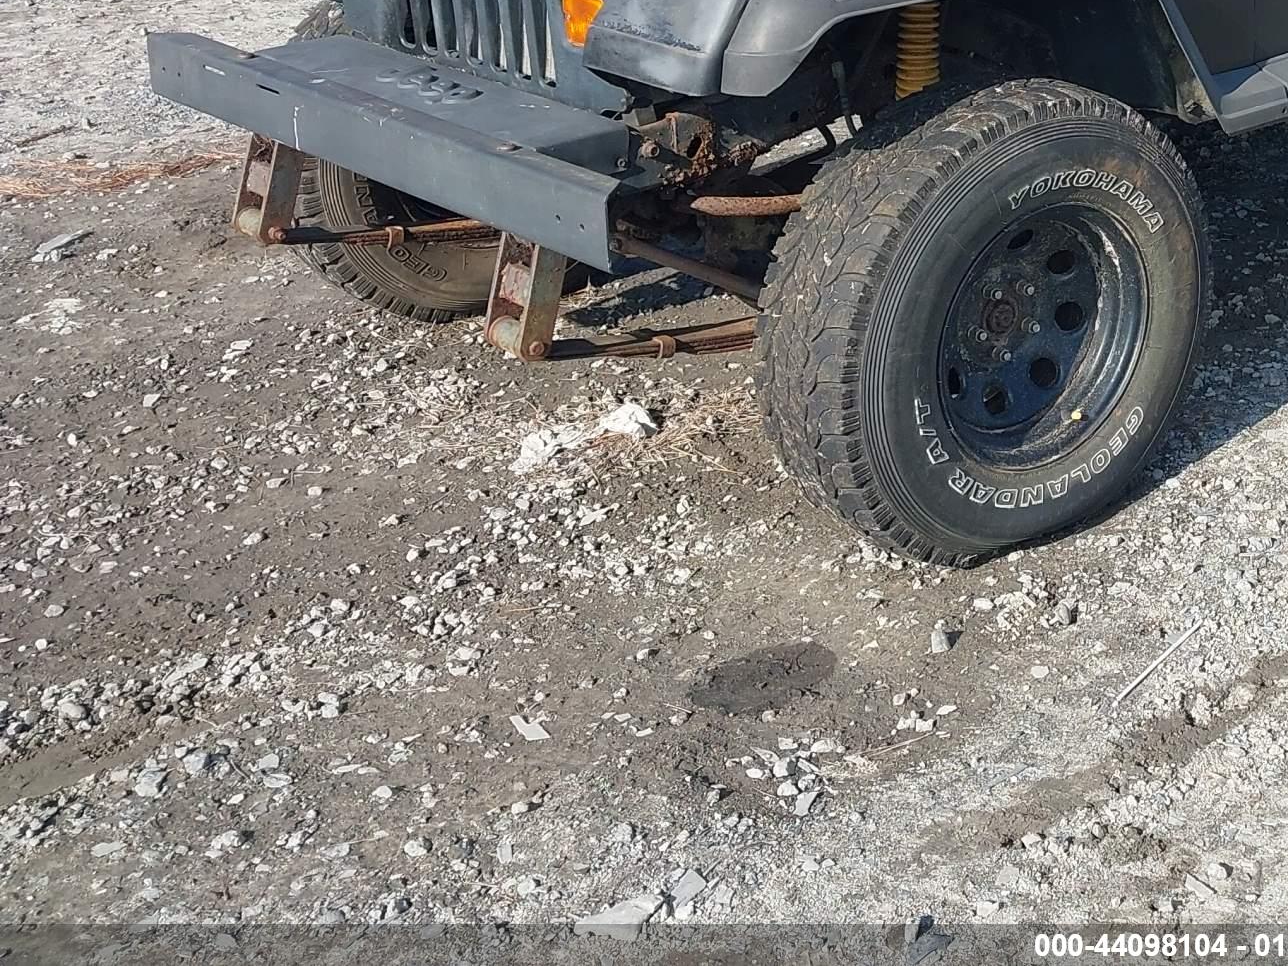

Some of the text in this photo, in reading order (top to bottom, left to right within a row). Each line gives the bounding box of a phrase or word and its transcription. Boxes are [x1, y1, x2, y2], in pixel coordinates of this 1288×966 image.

[1008, 169, 1164, 234] YOKOHAMA
[914, 398, 1144, 508] GEOLANDAR A/T
